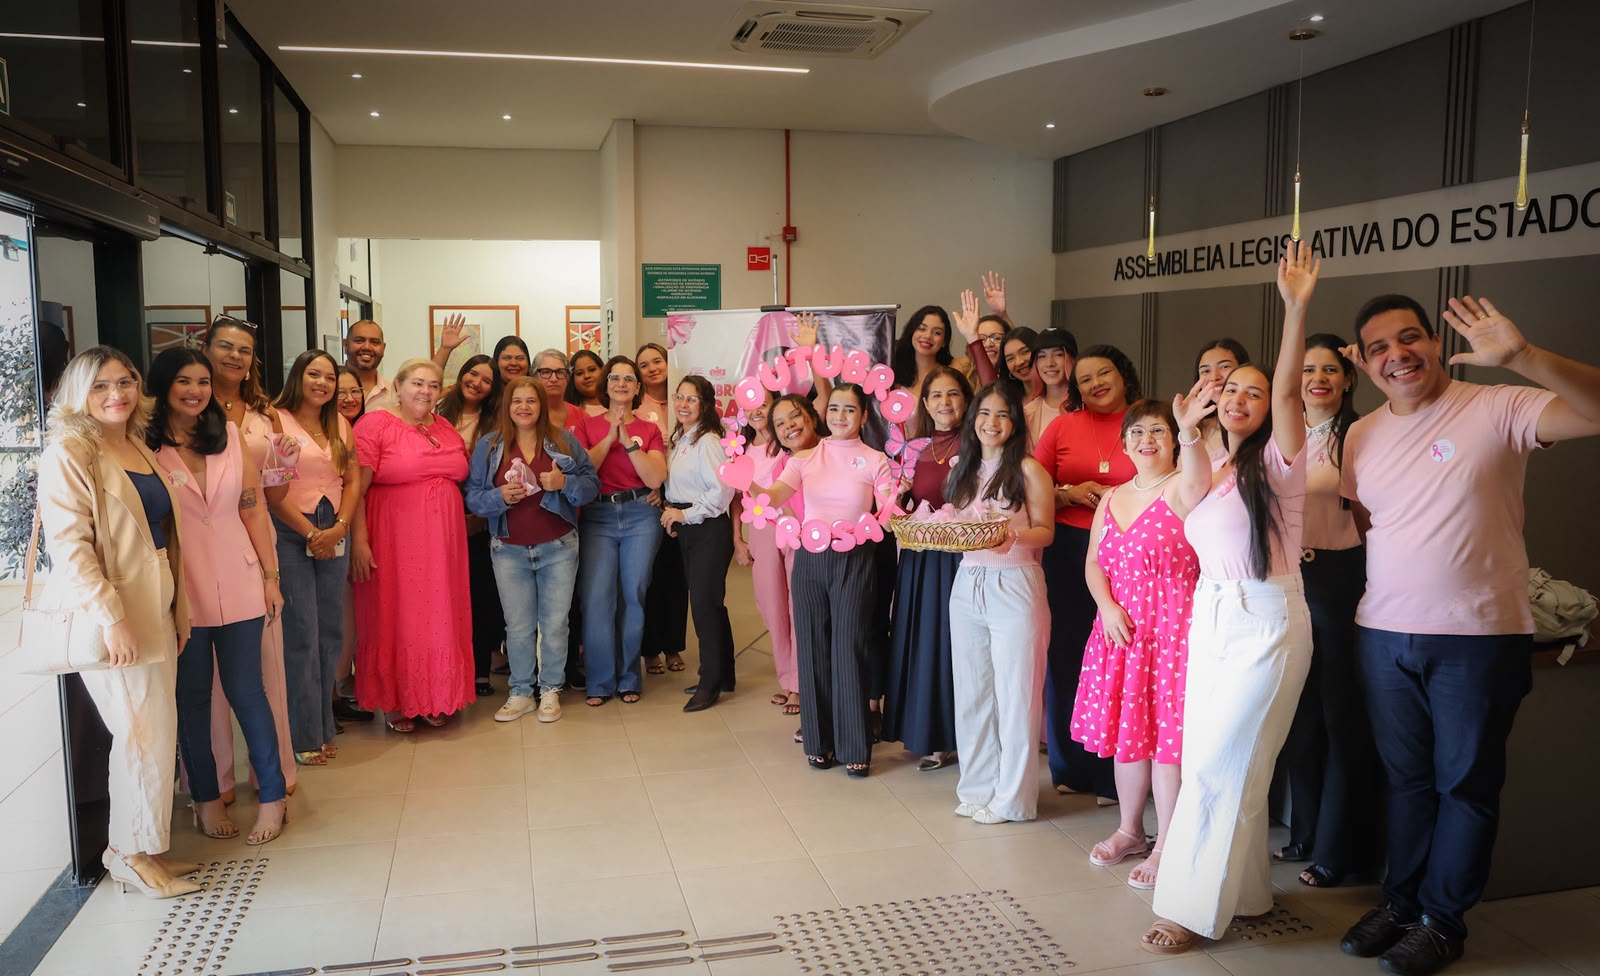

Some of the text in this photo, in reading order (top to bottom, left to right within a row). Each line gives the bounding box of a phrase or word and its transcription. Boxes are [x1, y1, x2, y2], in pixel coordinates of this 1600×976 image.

[1114, 244, 1224, 281] ASSEMBLEIA
[1392, 213, 1440, 251] DO
[1450, 187, 1600, 244] ESTADO
[736, 344, 914, 424] OUTUBRO
[776, 513, 884, 552] ROSA
